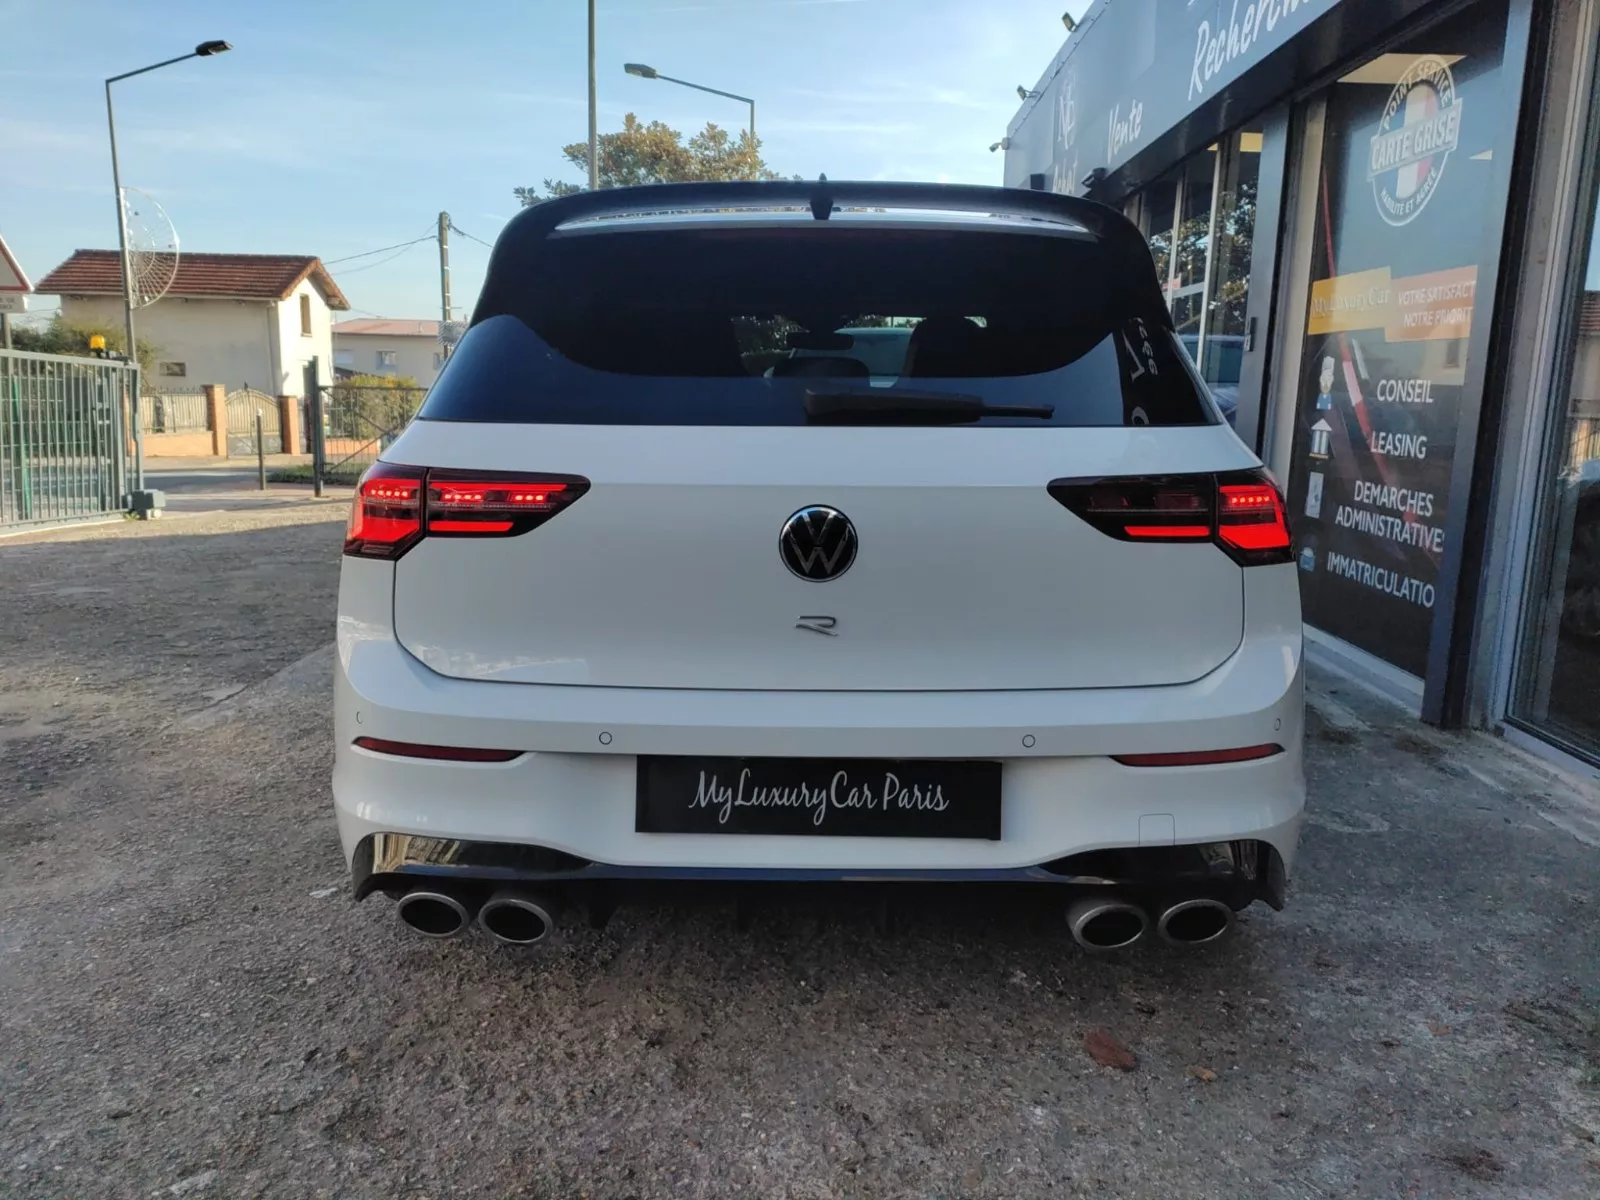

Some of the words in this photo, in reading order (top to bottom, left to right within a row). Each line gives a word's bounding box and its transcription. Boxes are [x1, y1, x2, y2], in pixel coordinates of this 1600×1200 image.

[1188, 0, 1309, 101] Recherc
[1383, 71, 1415, 131] POINT
[1417, 61, 1452, 108] SERVICE
[1107, 98, 1143, 165] Vente
[1371, 131, 1414, 171] CARTE
[1414, 112, 1456, 153] GRISE
[1405, 198, 1415, 214] ET
[1403, 310, 1433, 328] NOTRE
[1376, 378, 1434, 403] CONSEIL
[1370, 430, 1428, 459] LEASING
[1354, 480, 1434, 518] DEMARCHES
[1327, 551, 1435, 608] IMMATRICULATIO
[795, 615, 839, 637] R
